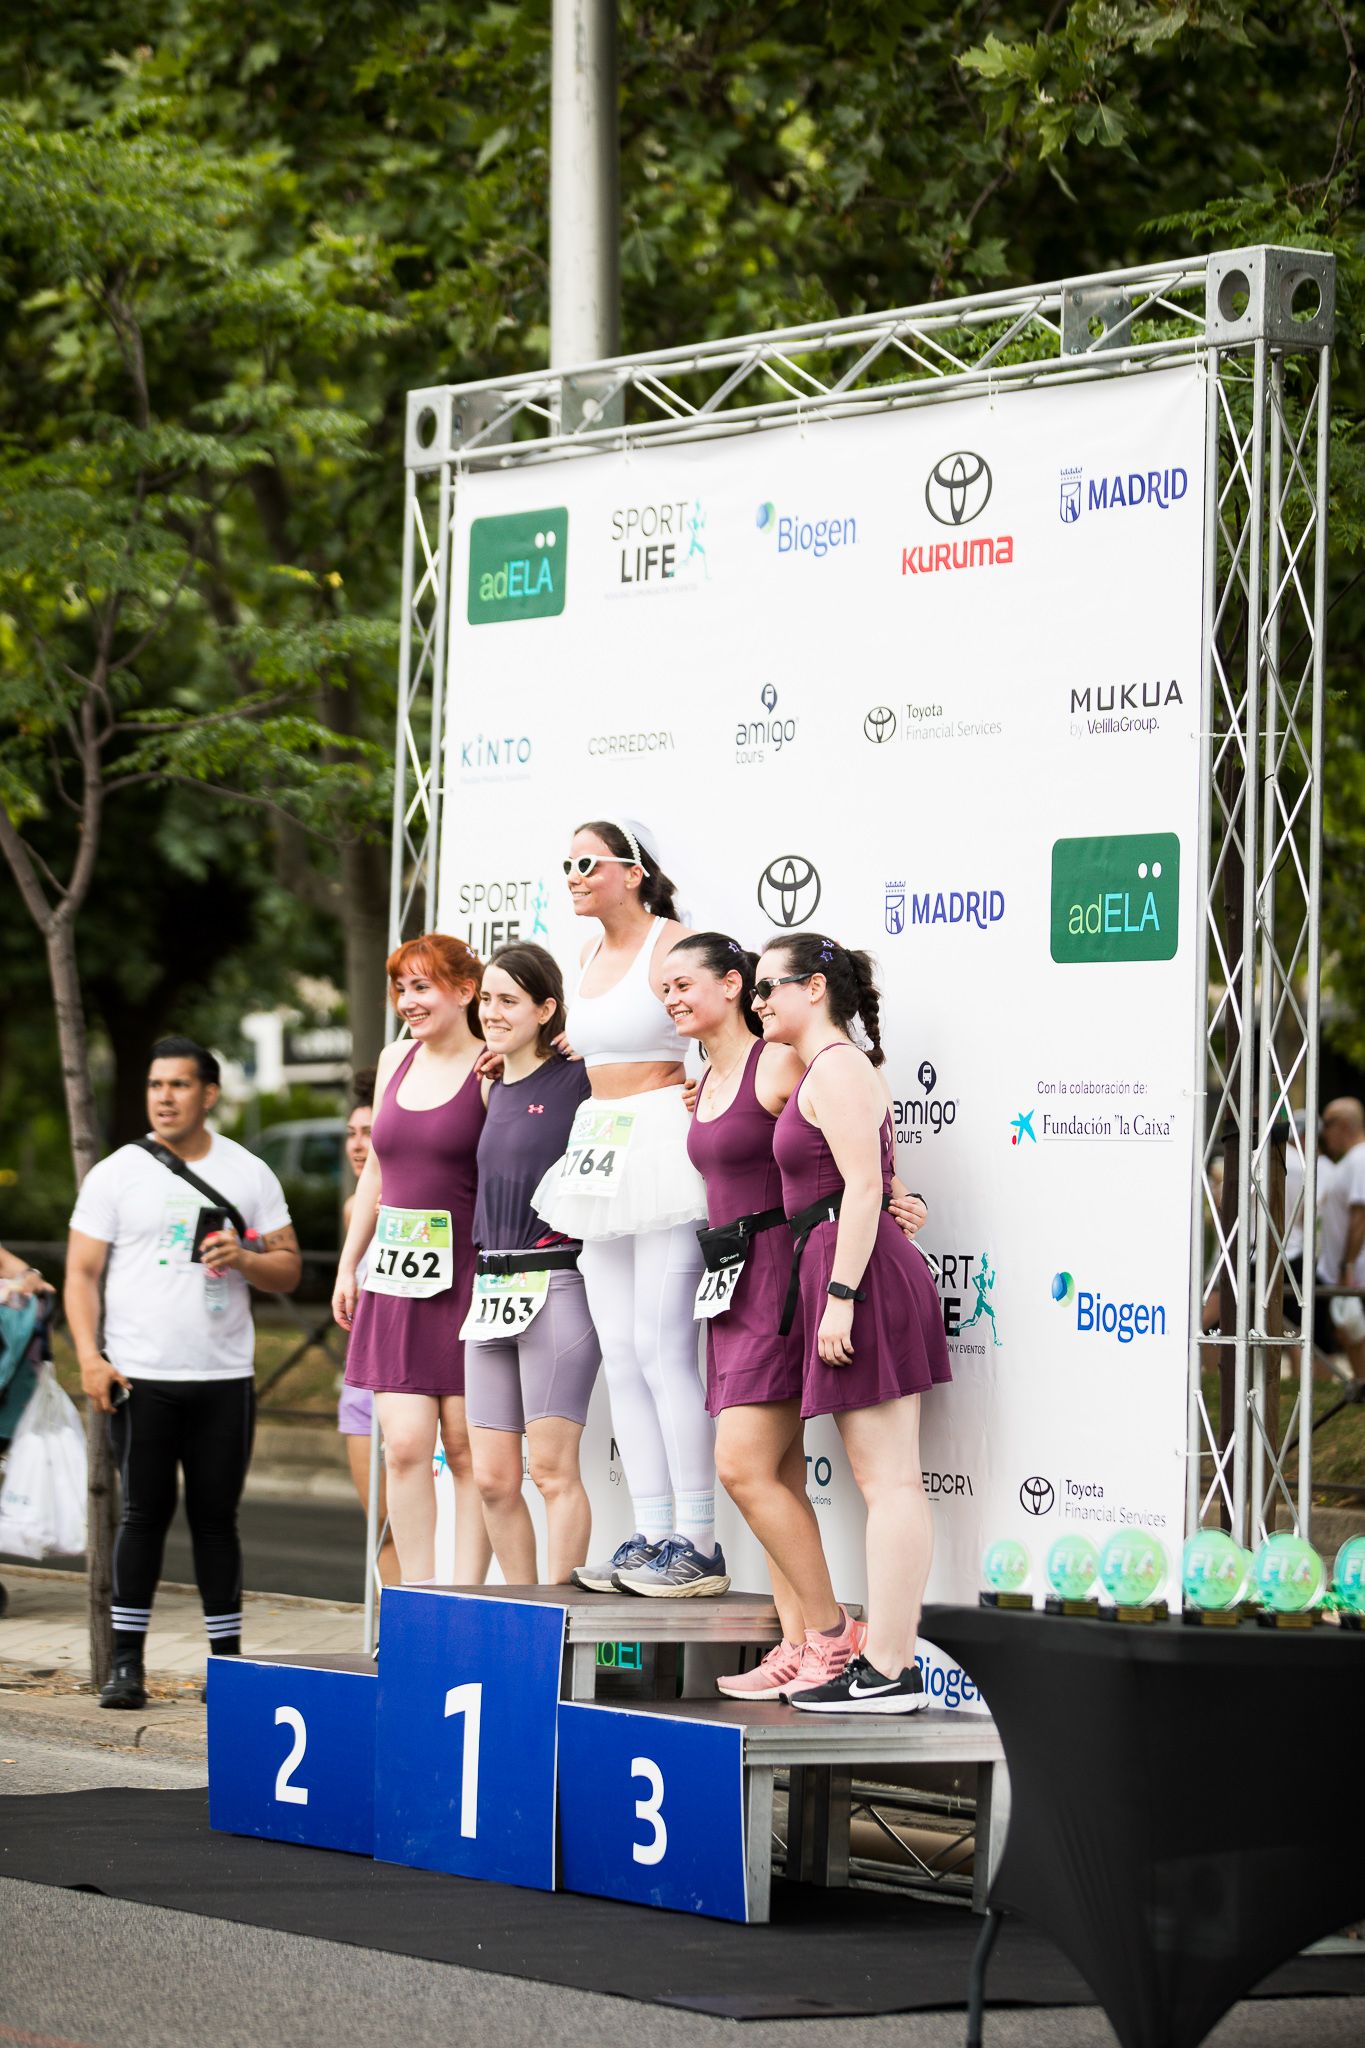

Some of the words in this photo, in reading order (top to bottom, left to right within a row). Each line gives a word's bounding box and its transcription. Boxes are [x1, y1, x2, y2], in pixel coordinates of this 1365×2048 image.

[1089, 468, 1188, 511] MADRID
[612, 502, 688, 541] SPORT
[778, 515, 856, 557] Biogen
[480, 557, 553, 601] adELA
[621, 544, 676, 583] LIFE
[906, 703, 943, 721] Toyota
[1070, 679, 1183, 714] MUKUA
[735, 719, 796, 751] amigo
[906, 721, 954, 741] Financial
[957, 720, 1002, 737] Services
[736, 749, 765, 764] tours
[460, 881, 532, 914] SPORT
[912, 890, 1005, 929] MADRID
[1068, 891, 1161, 934] adELA
[1037, 1080, 1056, 1094] Con
[1058, 1081, 1067, 1094] la
[1069, 1080, 1130, 1094] colaboración
[1133, 1080, 1148, 1094] de:
[895, 1130, 922, 1144] ours
[1043, 1114, 1112, 1135] Fundación
[560, 1148, 616, 1178] 1764
[376, 1248, 441, 1278] 1762
[475, 1296, 535, 1325] 1763
[1077, 1292, 1166, 1343] Biogen
[960, 1344, 986, 1355] EVENTOS
[1065, 1479, 1104, 1500] Toyota
[1065, 1502, 1116, 1523] Financial
[1119, 1507, 1167, 1528] Services
[273, 1705, 309, 1806] 2
[443, 1683, 482, 1838] 1
[631, 1756, 668, 1866] 3
